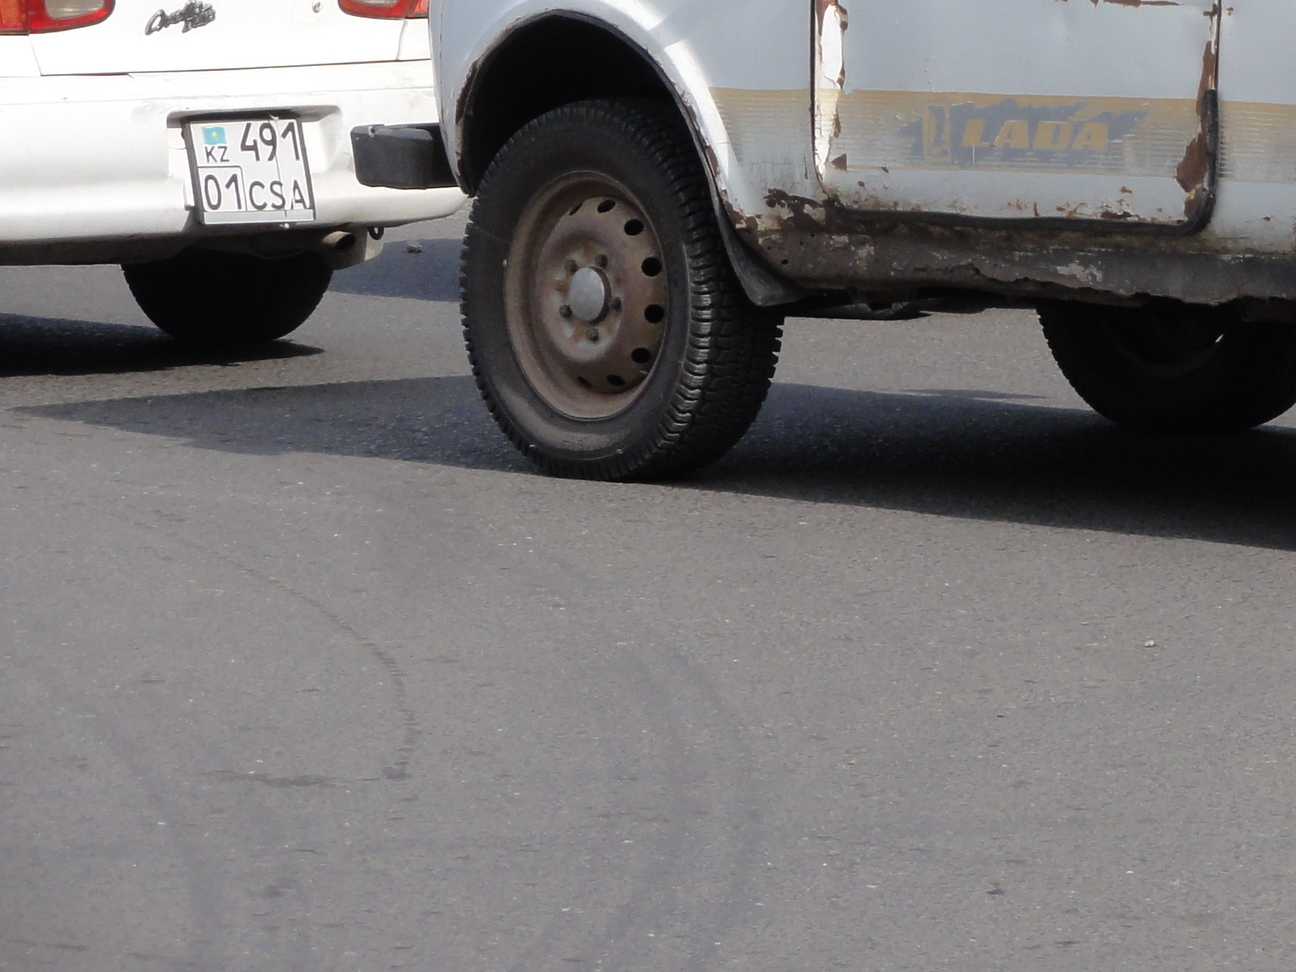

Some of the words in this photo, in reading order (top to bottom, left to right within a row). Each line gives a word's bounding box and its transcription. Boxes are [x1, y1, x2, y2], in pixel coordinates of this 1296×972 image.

[204, 145, 230, 163] KZ
[240, 121, 300, 162] 491
[961, 118, 1111, 151] LADA
[204, 173, 242, 210] 01
[248, 180, 308, 210] CSA
